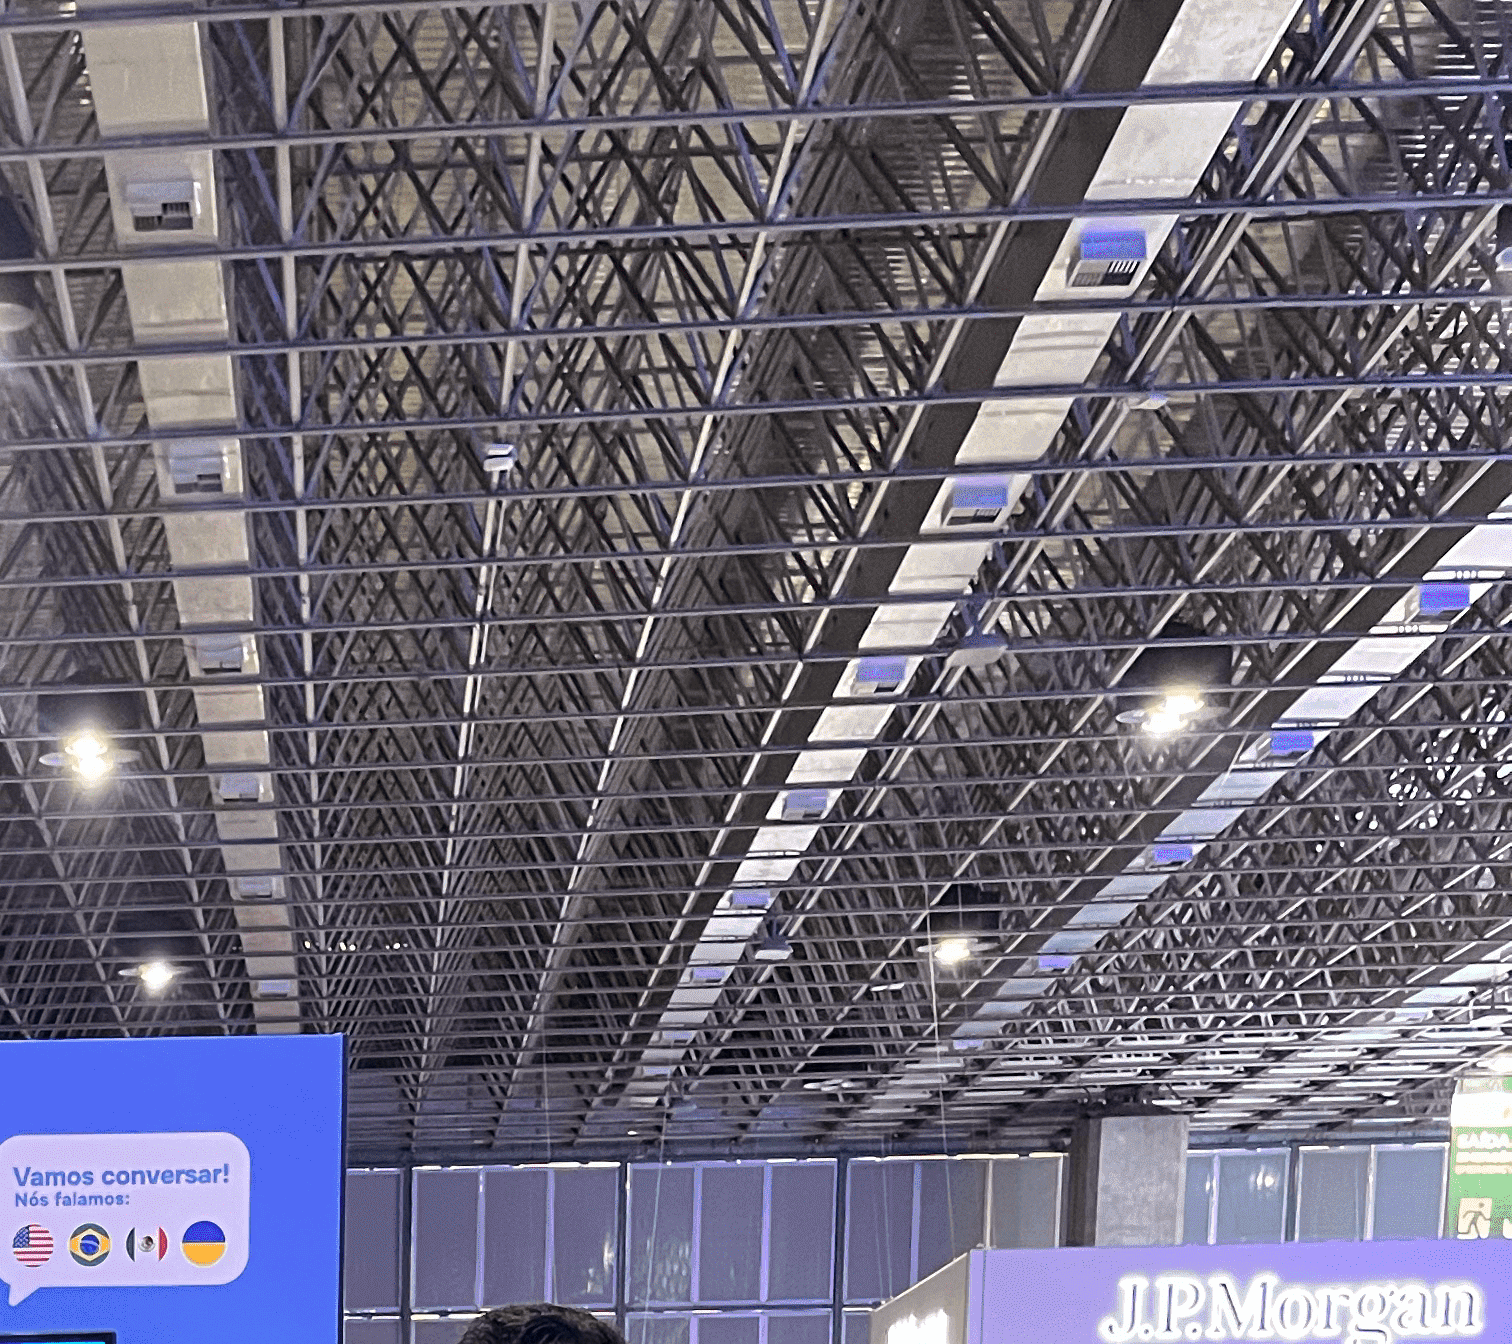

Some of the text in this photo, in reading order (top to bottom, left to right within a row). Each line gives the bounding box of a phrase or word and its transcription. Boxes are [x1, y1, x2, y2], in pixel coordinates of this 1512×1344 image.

[12, 1163, 230, 1187] Vamos conversar!
[15, 1191, 130, 1207] Nós falamos:
